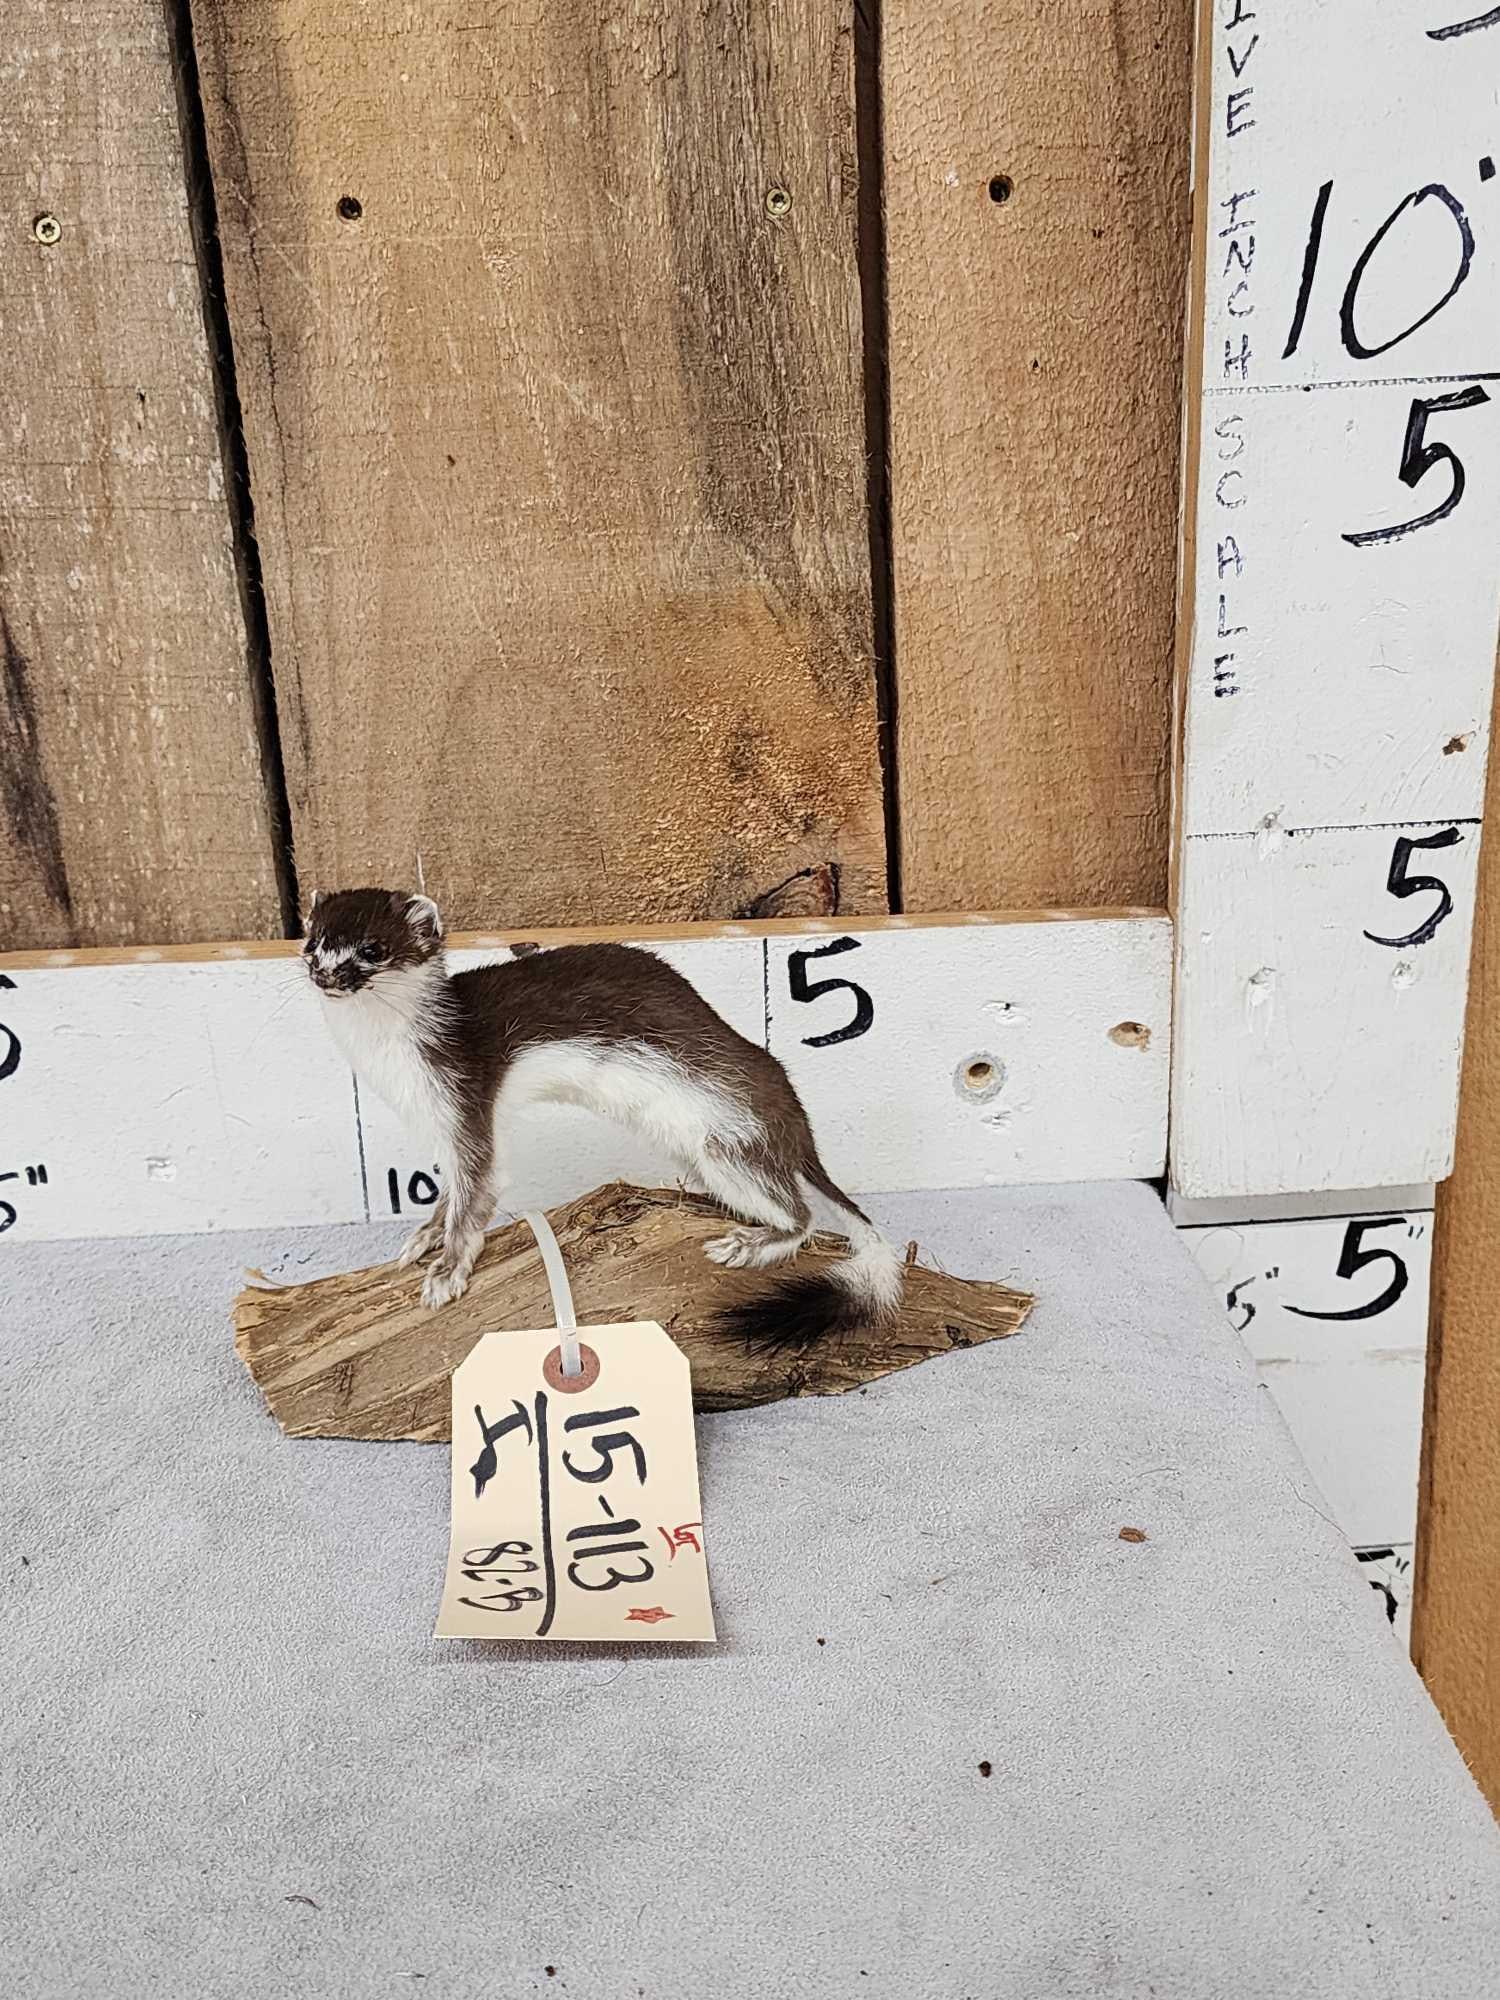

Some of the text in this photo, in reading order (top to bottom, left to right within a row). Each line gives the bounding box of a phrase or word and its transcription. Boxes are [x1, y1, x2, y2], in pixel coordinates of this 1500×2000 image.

[1219, 189, 1259, 379] INCH
[1341, 384, 1492, 548] 5
[1214, 415, 1248, 698] SCALE
[1363, 826, 1465, 948] 5
[787, 936, 874, 1048] 5
[562, 1405, 655, 1592] 15-113
